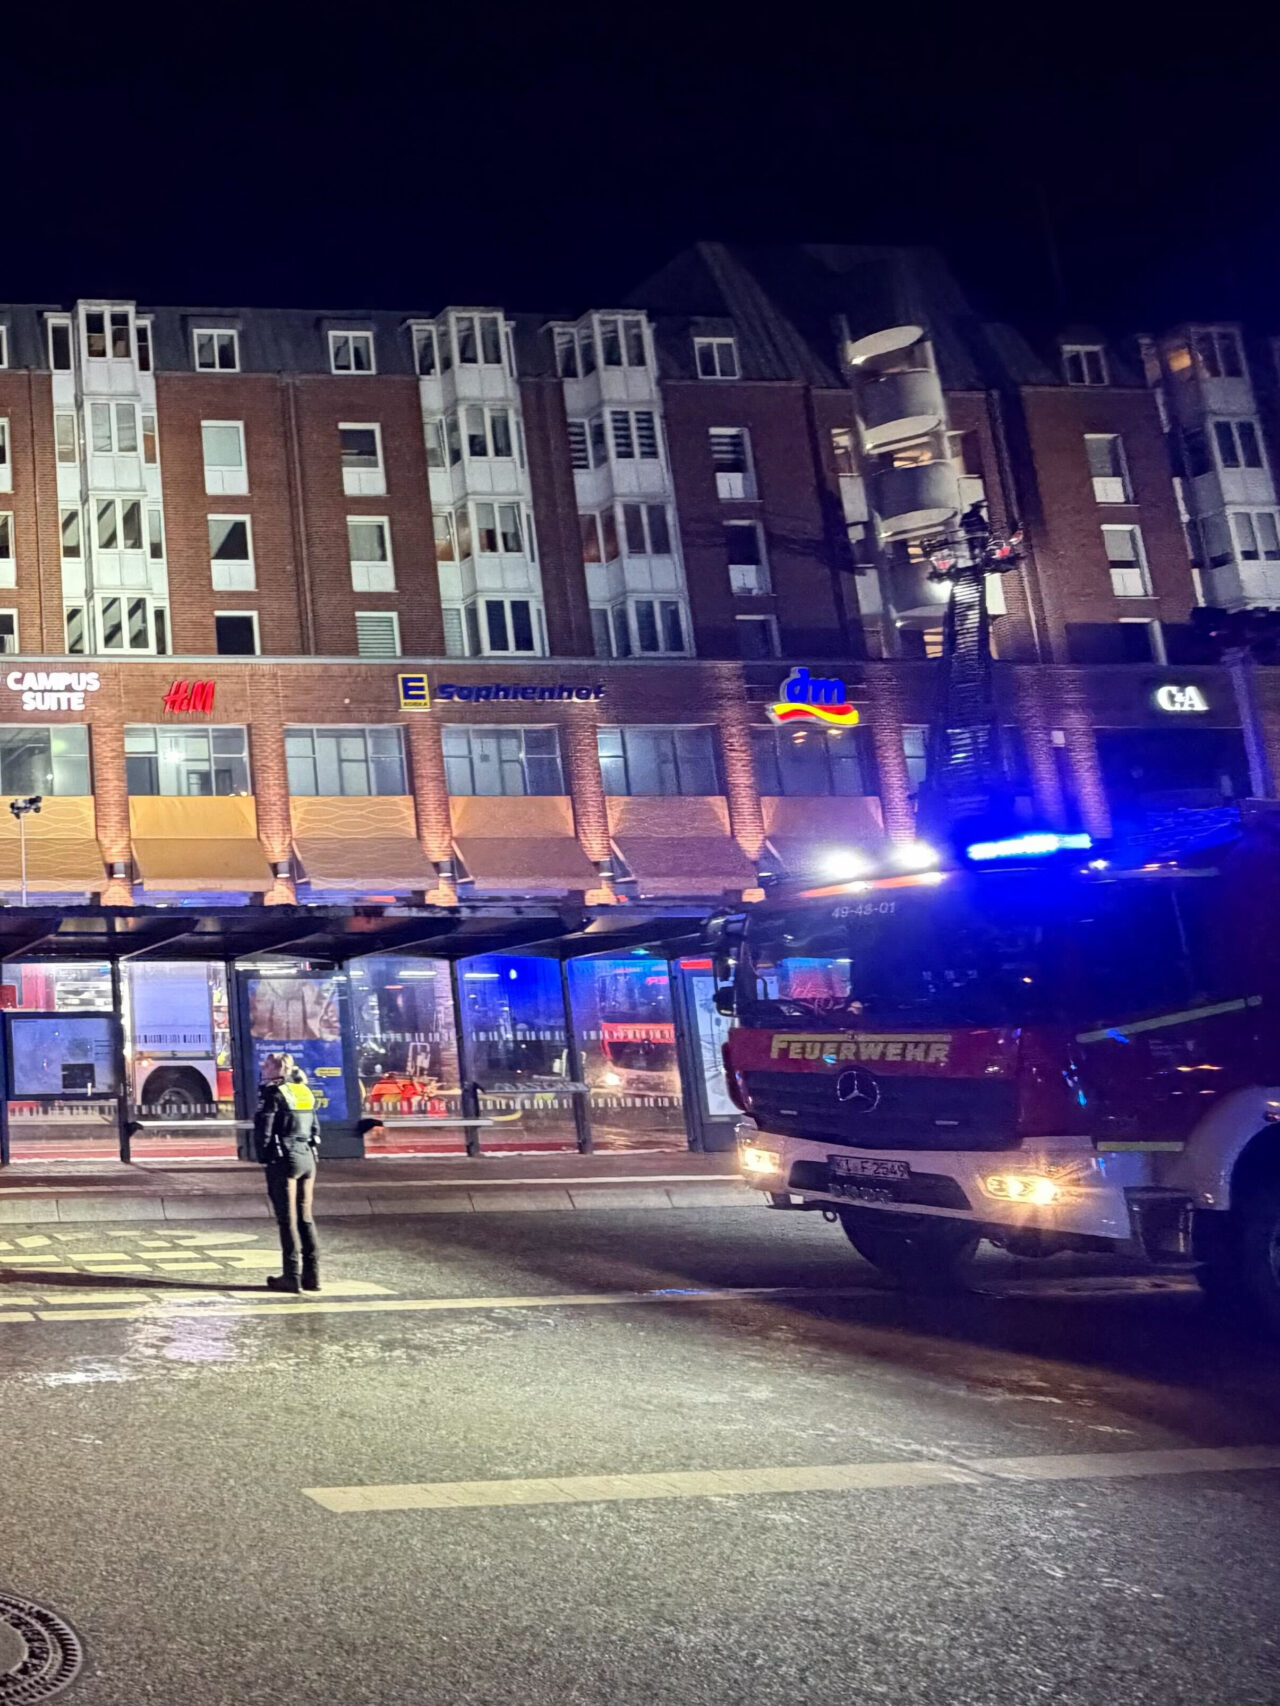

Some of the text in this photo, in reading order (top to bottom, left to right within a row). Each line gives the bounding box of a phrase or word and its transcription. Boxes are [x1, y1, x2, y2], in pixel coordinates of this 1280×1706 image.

[6, 671, 101, 692] CAMPUS
[434, 683, 605, 703] Sophienhof
[781, 667, 846, 704] dm
[21, 691, 86, 711] SUITE
[162, 680, 216, 714] H&M
[1157, 685, 1209, 711] C&A
[770, 1034, 951, 1062] FEUERWEHR
